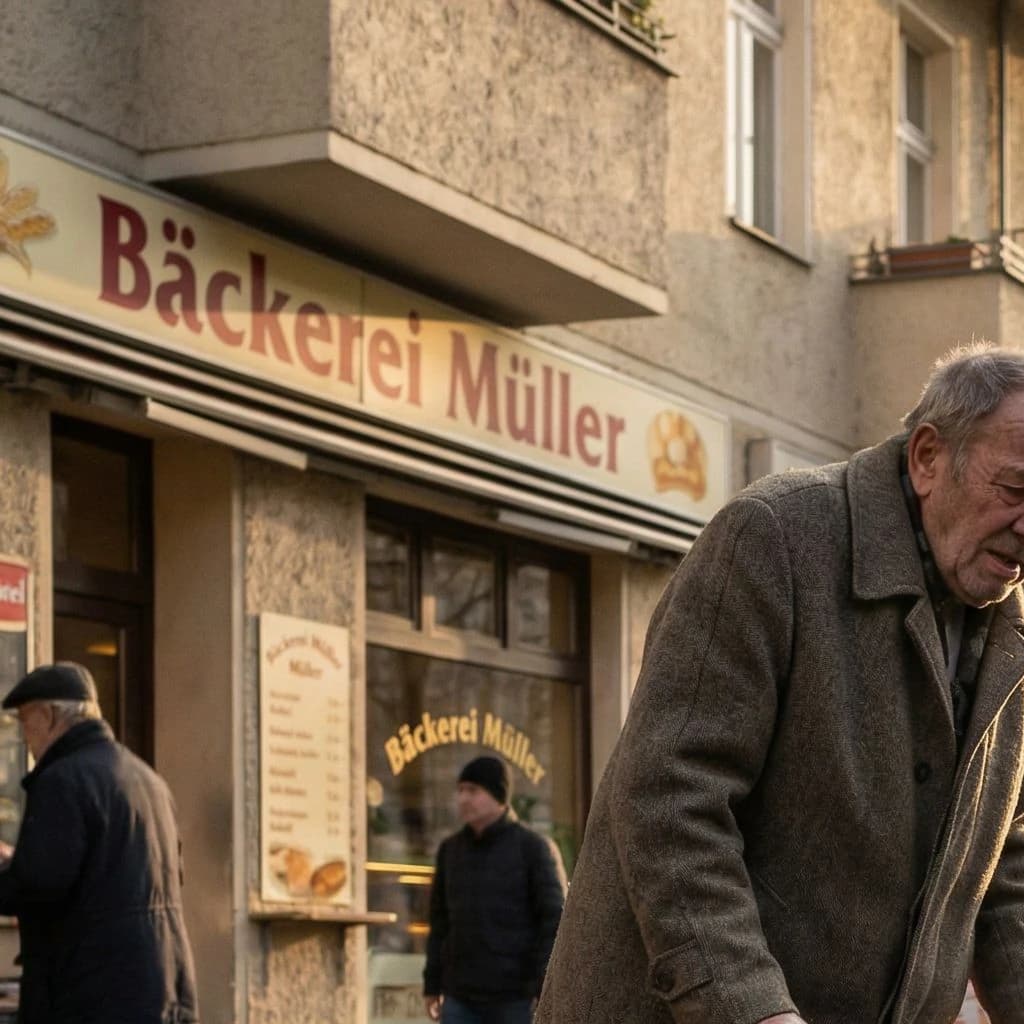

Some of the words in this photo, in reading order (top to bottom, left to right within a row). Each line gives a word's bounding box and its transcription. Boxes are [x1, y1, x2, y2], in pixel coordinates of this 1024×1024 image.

[98, 194, 422, 407] Bäckerei
[447, 330, 626, 474] Müller
[384, 707, 478, 777] Bäckerei
[482, 711, 547, 785] Müller
